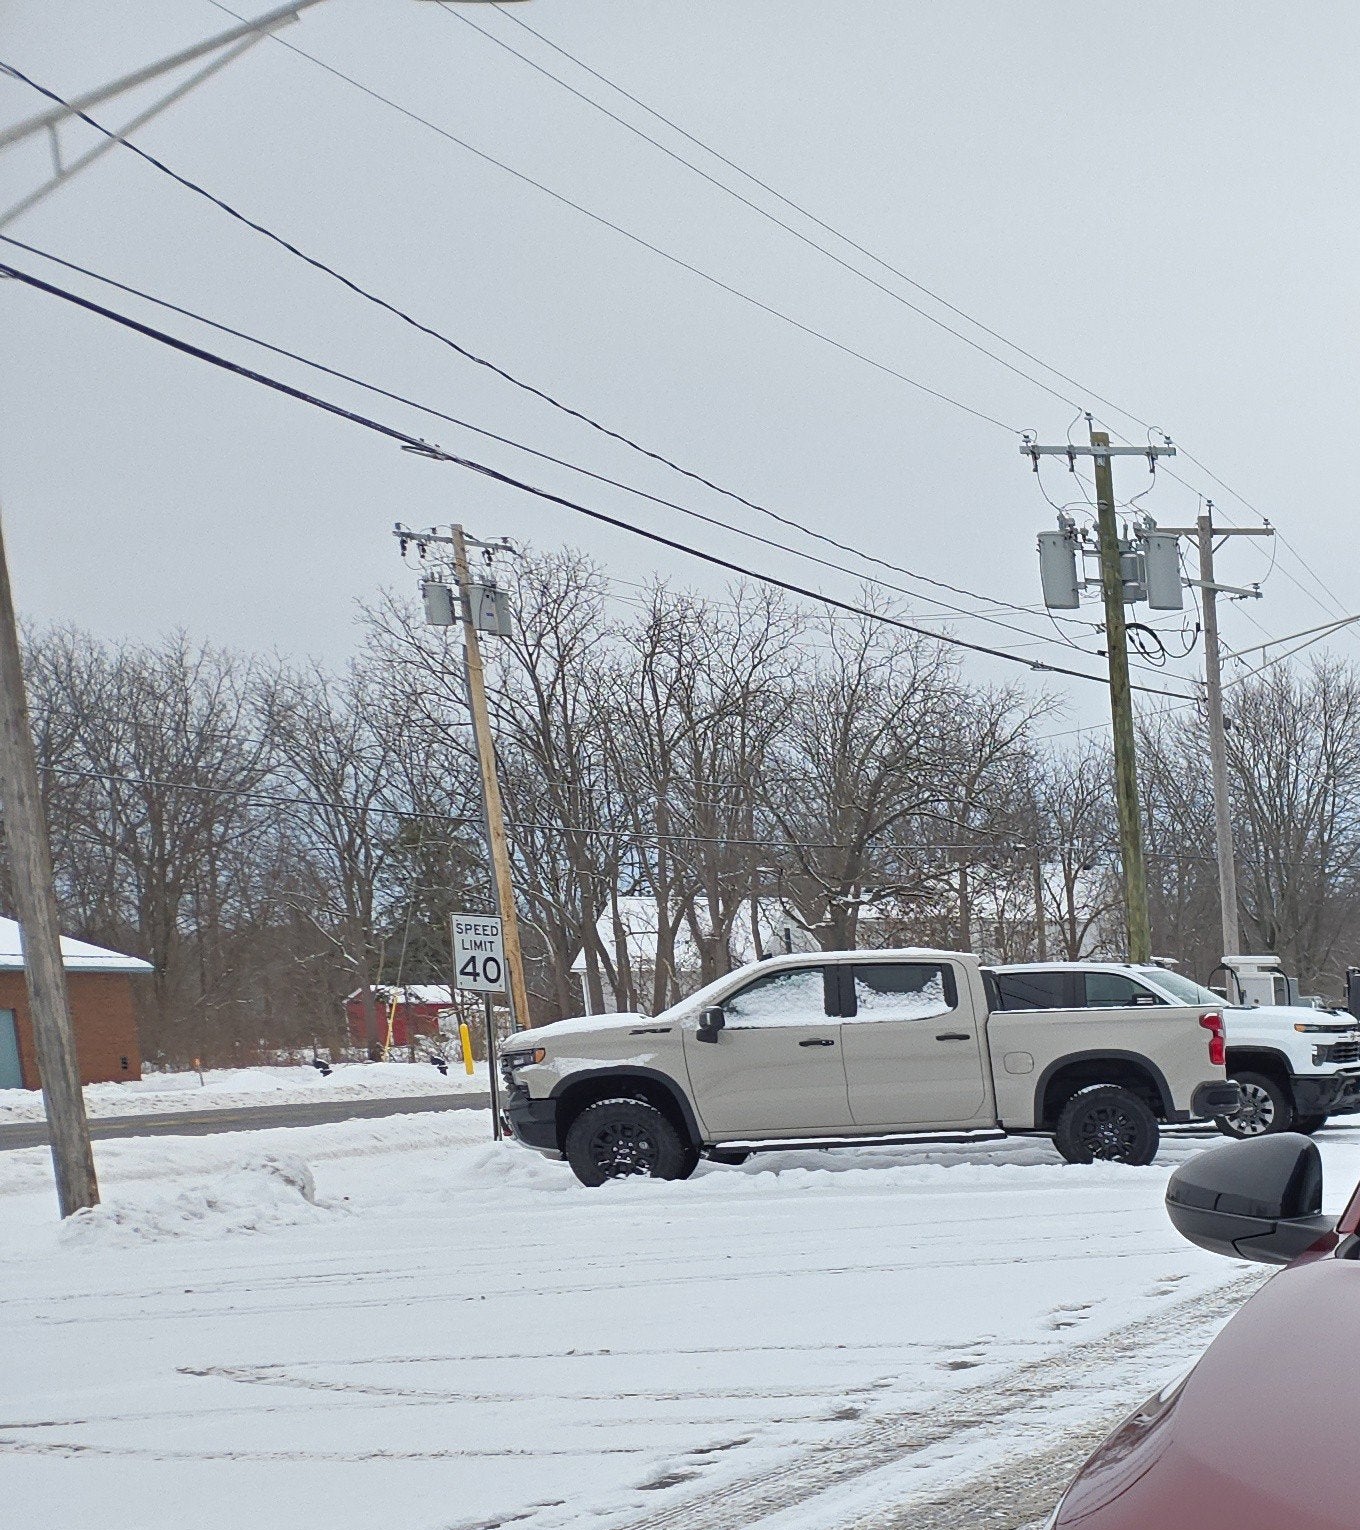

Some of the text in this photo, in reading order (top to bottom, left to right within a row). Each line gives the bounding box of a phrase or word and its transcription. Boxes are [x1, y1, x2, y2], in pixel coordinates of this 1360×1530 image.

[456, 922, 499, 936] SPEED
[461, 939, 495, 952] LIMIT
[459, 955, 501, 984] 40
